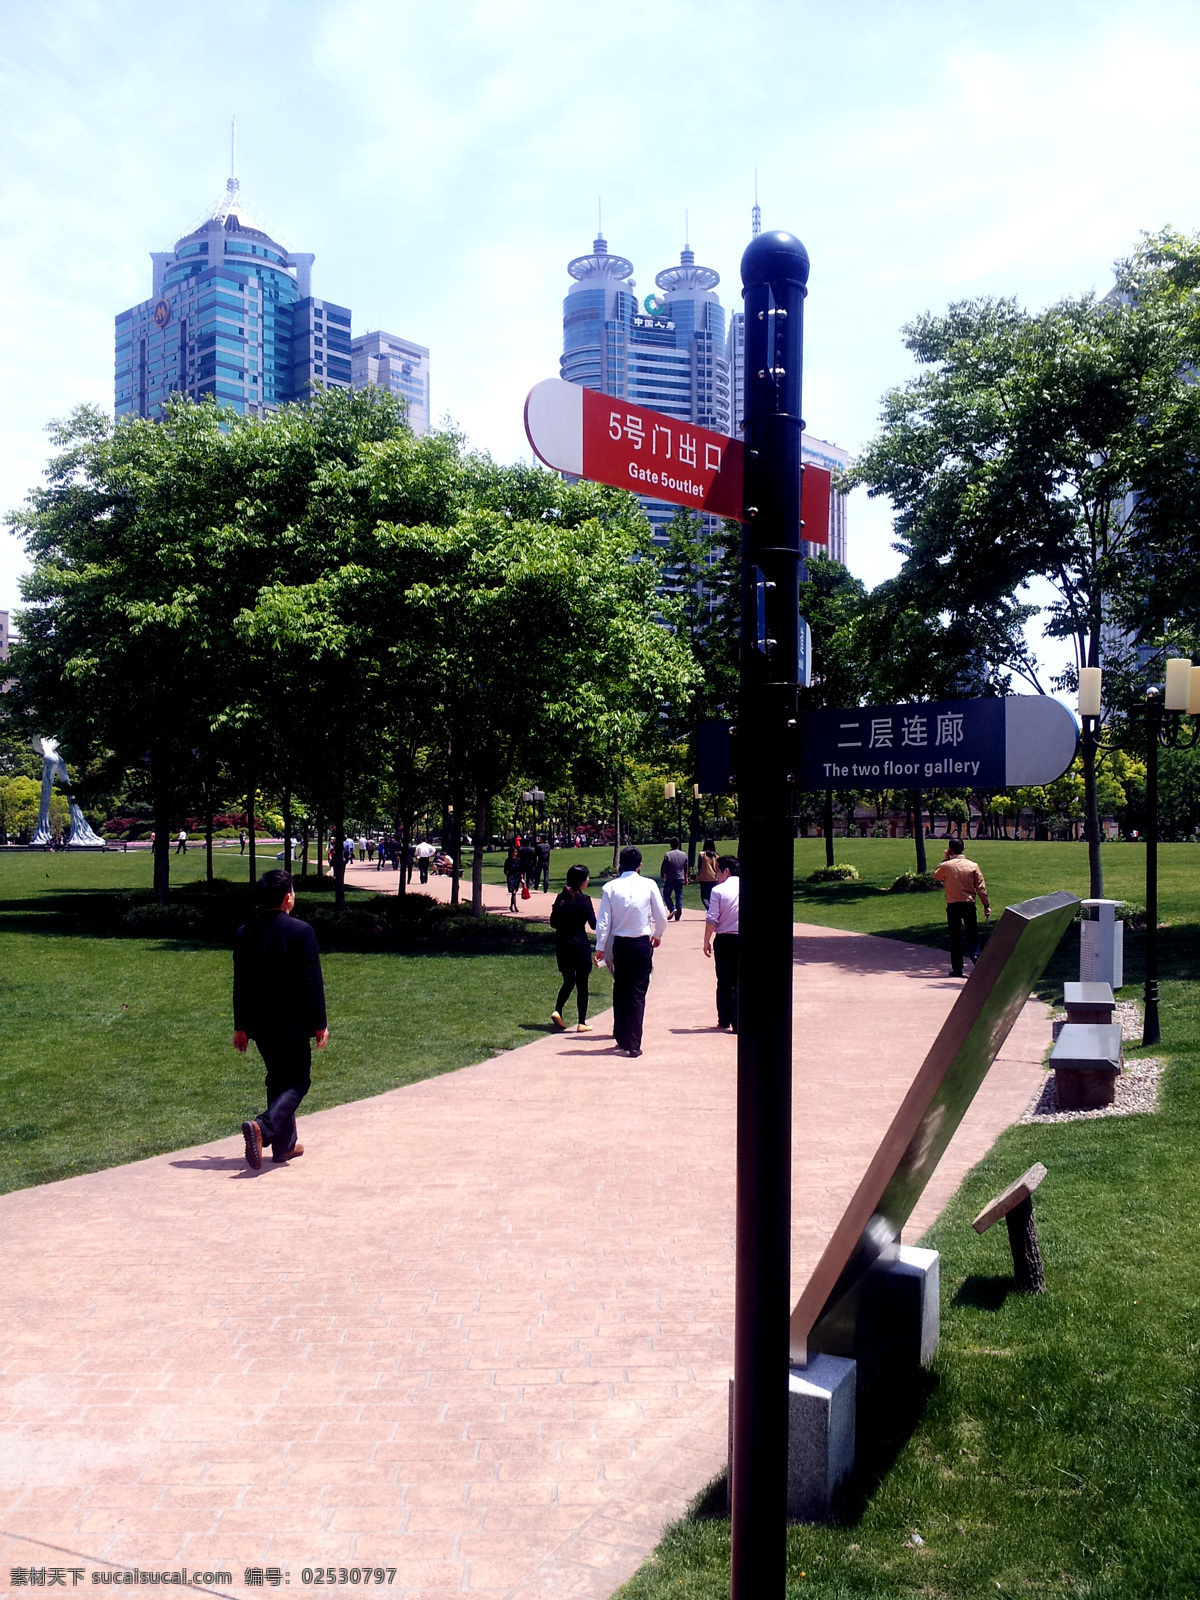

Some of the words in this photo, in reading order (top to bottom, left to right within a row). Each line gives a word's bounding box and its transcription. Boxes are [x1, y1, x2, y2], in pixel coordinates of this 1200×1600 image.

[608, 411, 722, 474] 5号门出口
[628, 462, 659, 485] Gate
[661, 471, 704, 498] 5outlet
[837, 711, 964, 749] 二层连廊
[823, 763, 849, 777] The
[852, 763, 880, 776] two
[883, 760, 920, 775] floor
[924, 758, 980, 777] gallery
